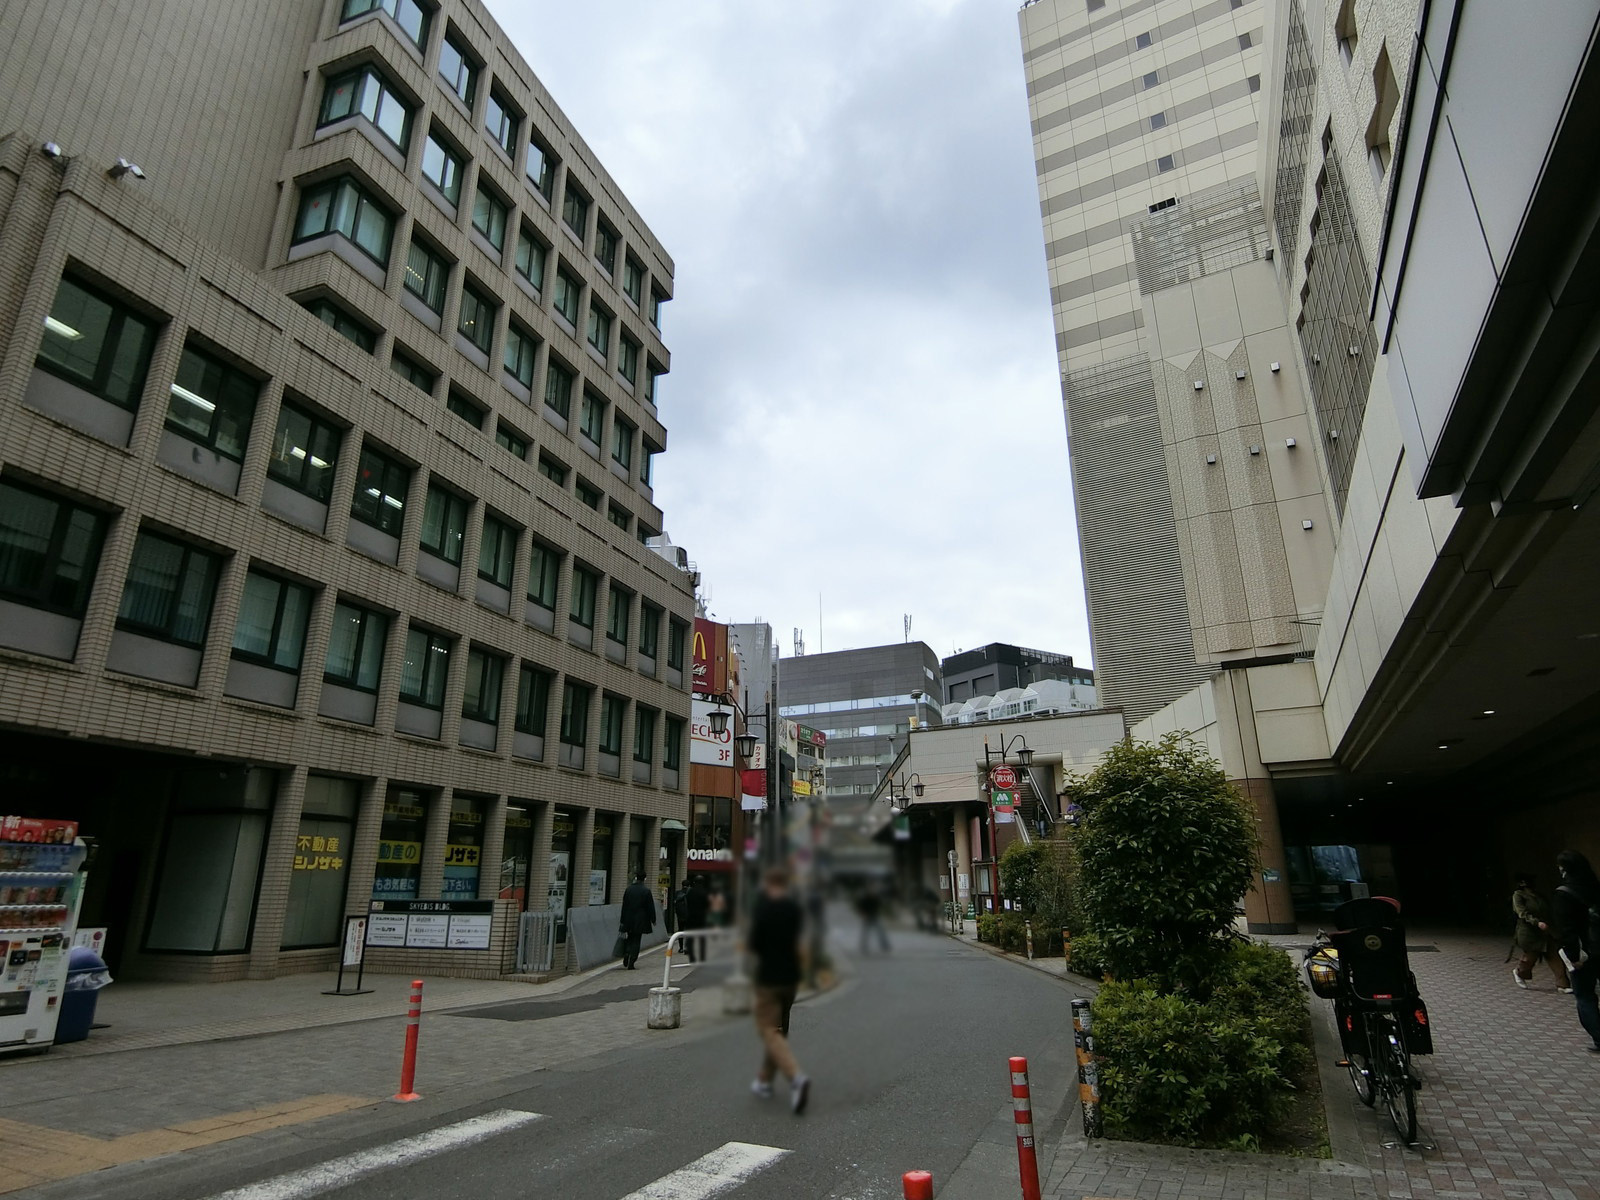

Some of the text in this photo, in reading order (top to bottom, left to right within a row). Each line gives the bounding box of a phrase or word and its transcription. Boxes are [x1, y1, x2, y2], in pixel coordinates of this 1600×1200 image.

[718, 749, 731, 761] 3F
[297, 835, 340, 852] 不動産
[294, 855, 344, 871] シノザキ
[445, 848, 477, 863] ノザキ
